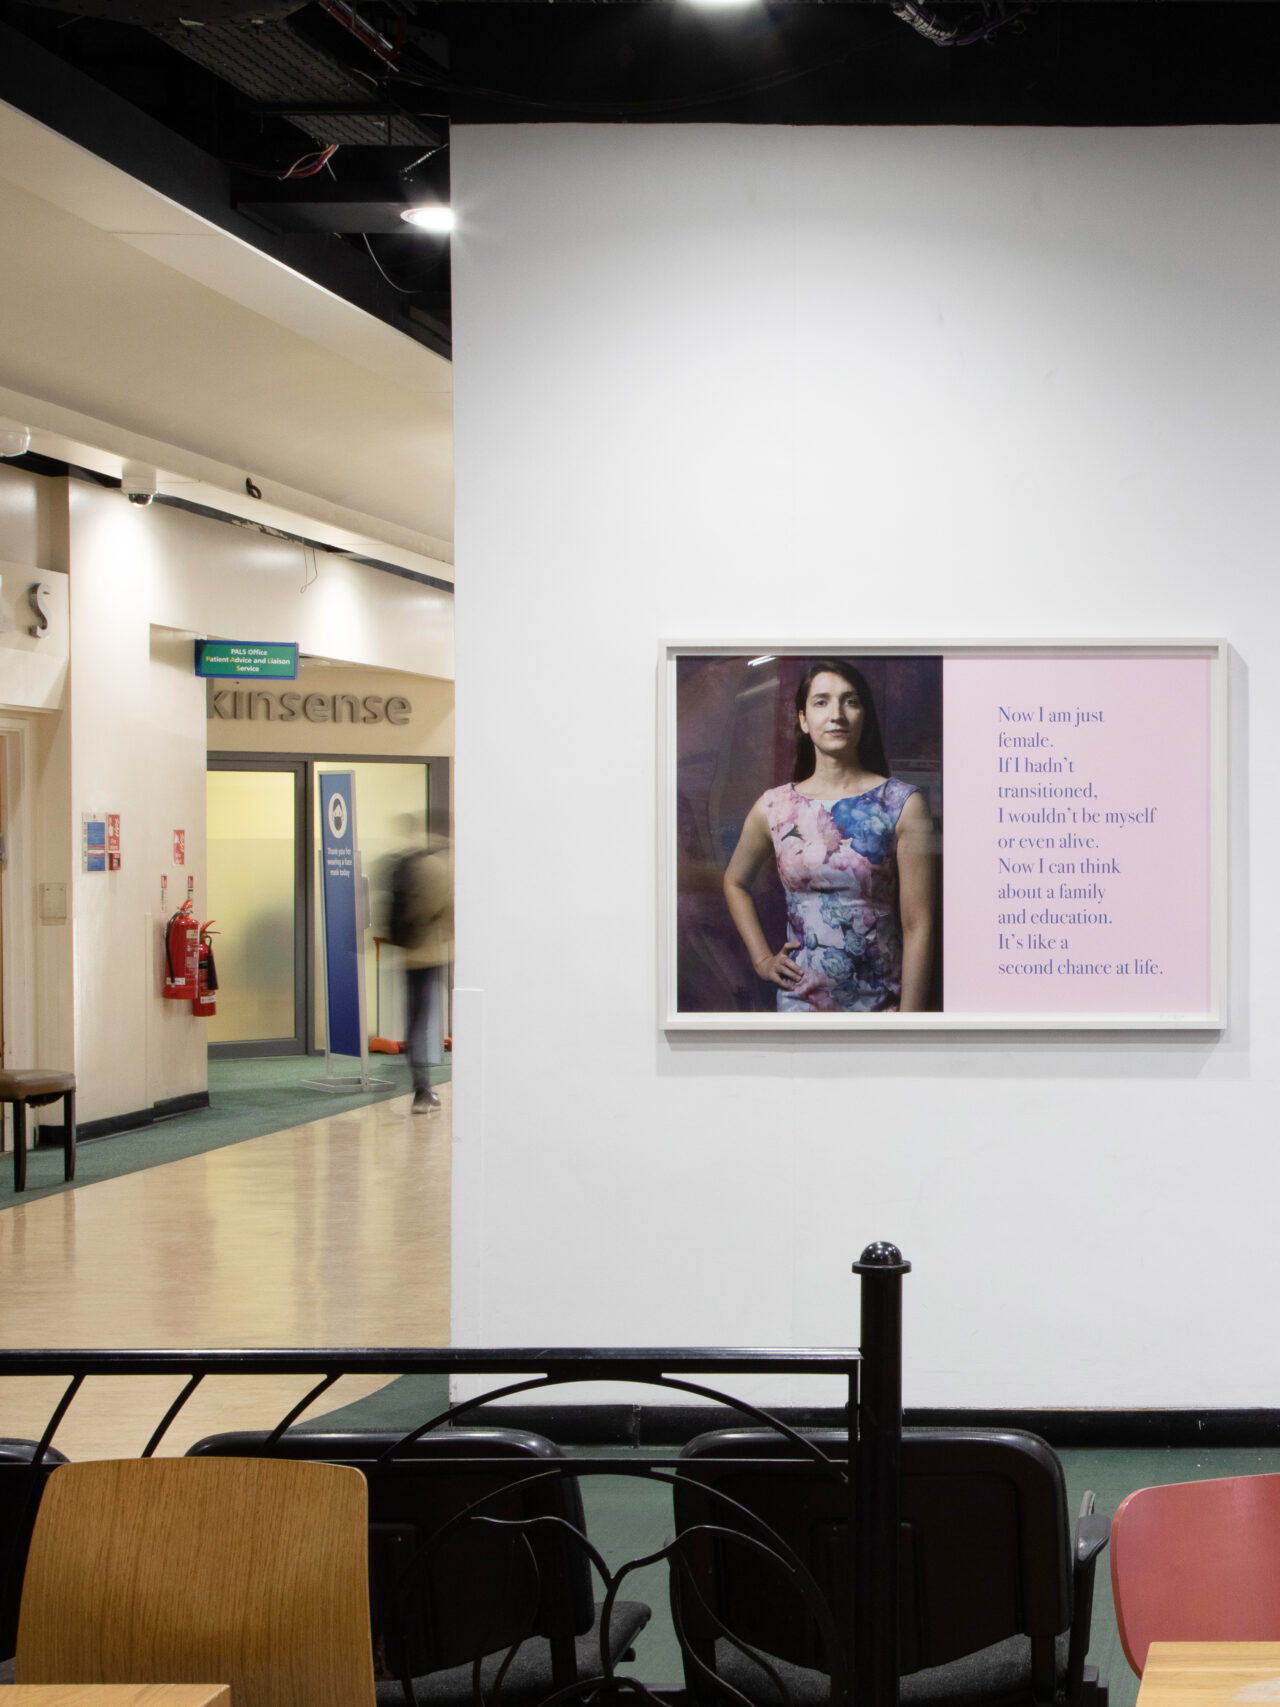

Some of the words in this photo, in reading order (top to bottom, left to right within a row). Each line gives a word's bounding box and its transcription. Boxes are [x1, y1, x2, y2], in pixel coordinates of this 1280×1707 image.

[248, 648, 268, 656] Office
[998, 706, 1033, 723] Now
[1039, 705, 1044, 723] I
[1048, 711, 1071, 723] am
[1074, 706, 1104, 728] just
[998, 731, 1054, 748] female.
[999, 756, 1013, 773] If
[1015, 756, 1020, 773] I
[1024, 756, 1074, 773] hadn’t
[998, 781, 1098, 800] transitioned,
[998, 807, 1004, 824] I
[1008, 807, 1077, 824] wouldn’t
[1082, 807, 1101, 824] be
[1104, 807, 1158, 829] myself
[997, 837, 1016, 849] or
[1018, 837, 1055, 849] even
[1059, 832, 1099, 849] alive.
[998, 857, 1033, 874] Now
[1039, 857, 1044, 874] I
[1048, 862, 1076, 874] can
[1079, 857, 1121, 874] think
[997, 882, 1042, 900] about
[1046, 888, 1055, 900] a
[1059, 882, 1104, 905] family
[997, 907, 1026, 925] and
[1030, 907, 1113, 925] education.
[999, 933, 1024, 950] It’s
[1027, 933, 1057, 950] like
[1060, 938, 1069, 950] a
[998, 958, 1053, 975] second
[1057, 958, 1112, 975] chance
[1115, 962, 1130, 975] at
[1134, 958, 1164, 975] life.
